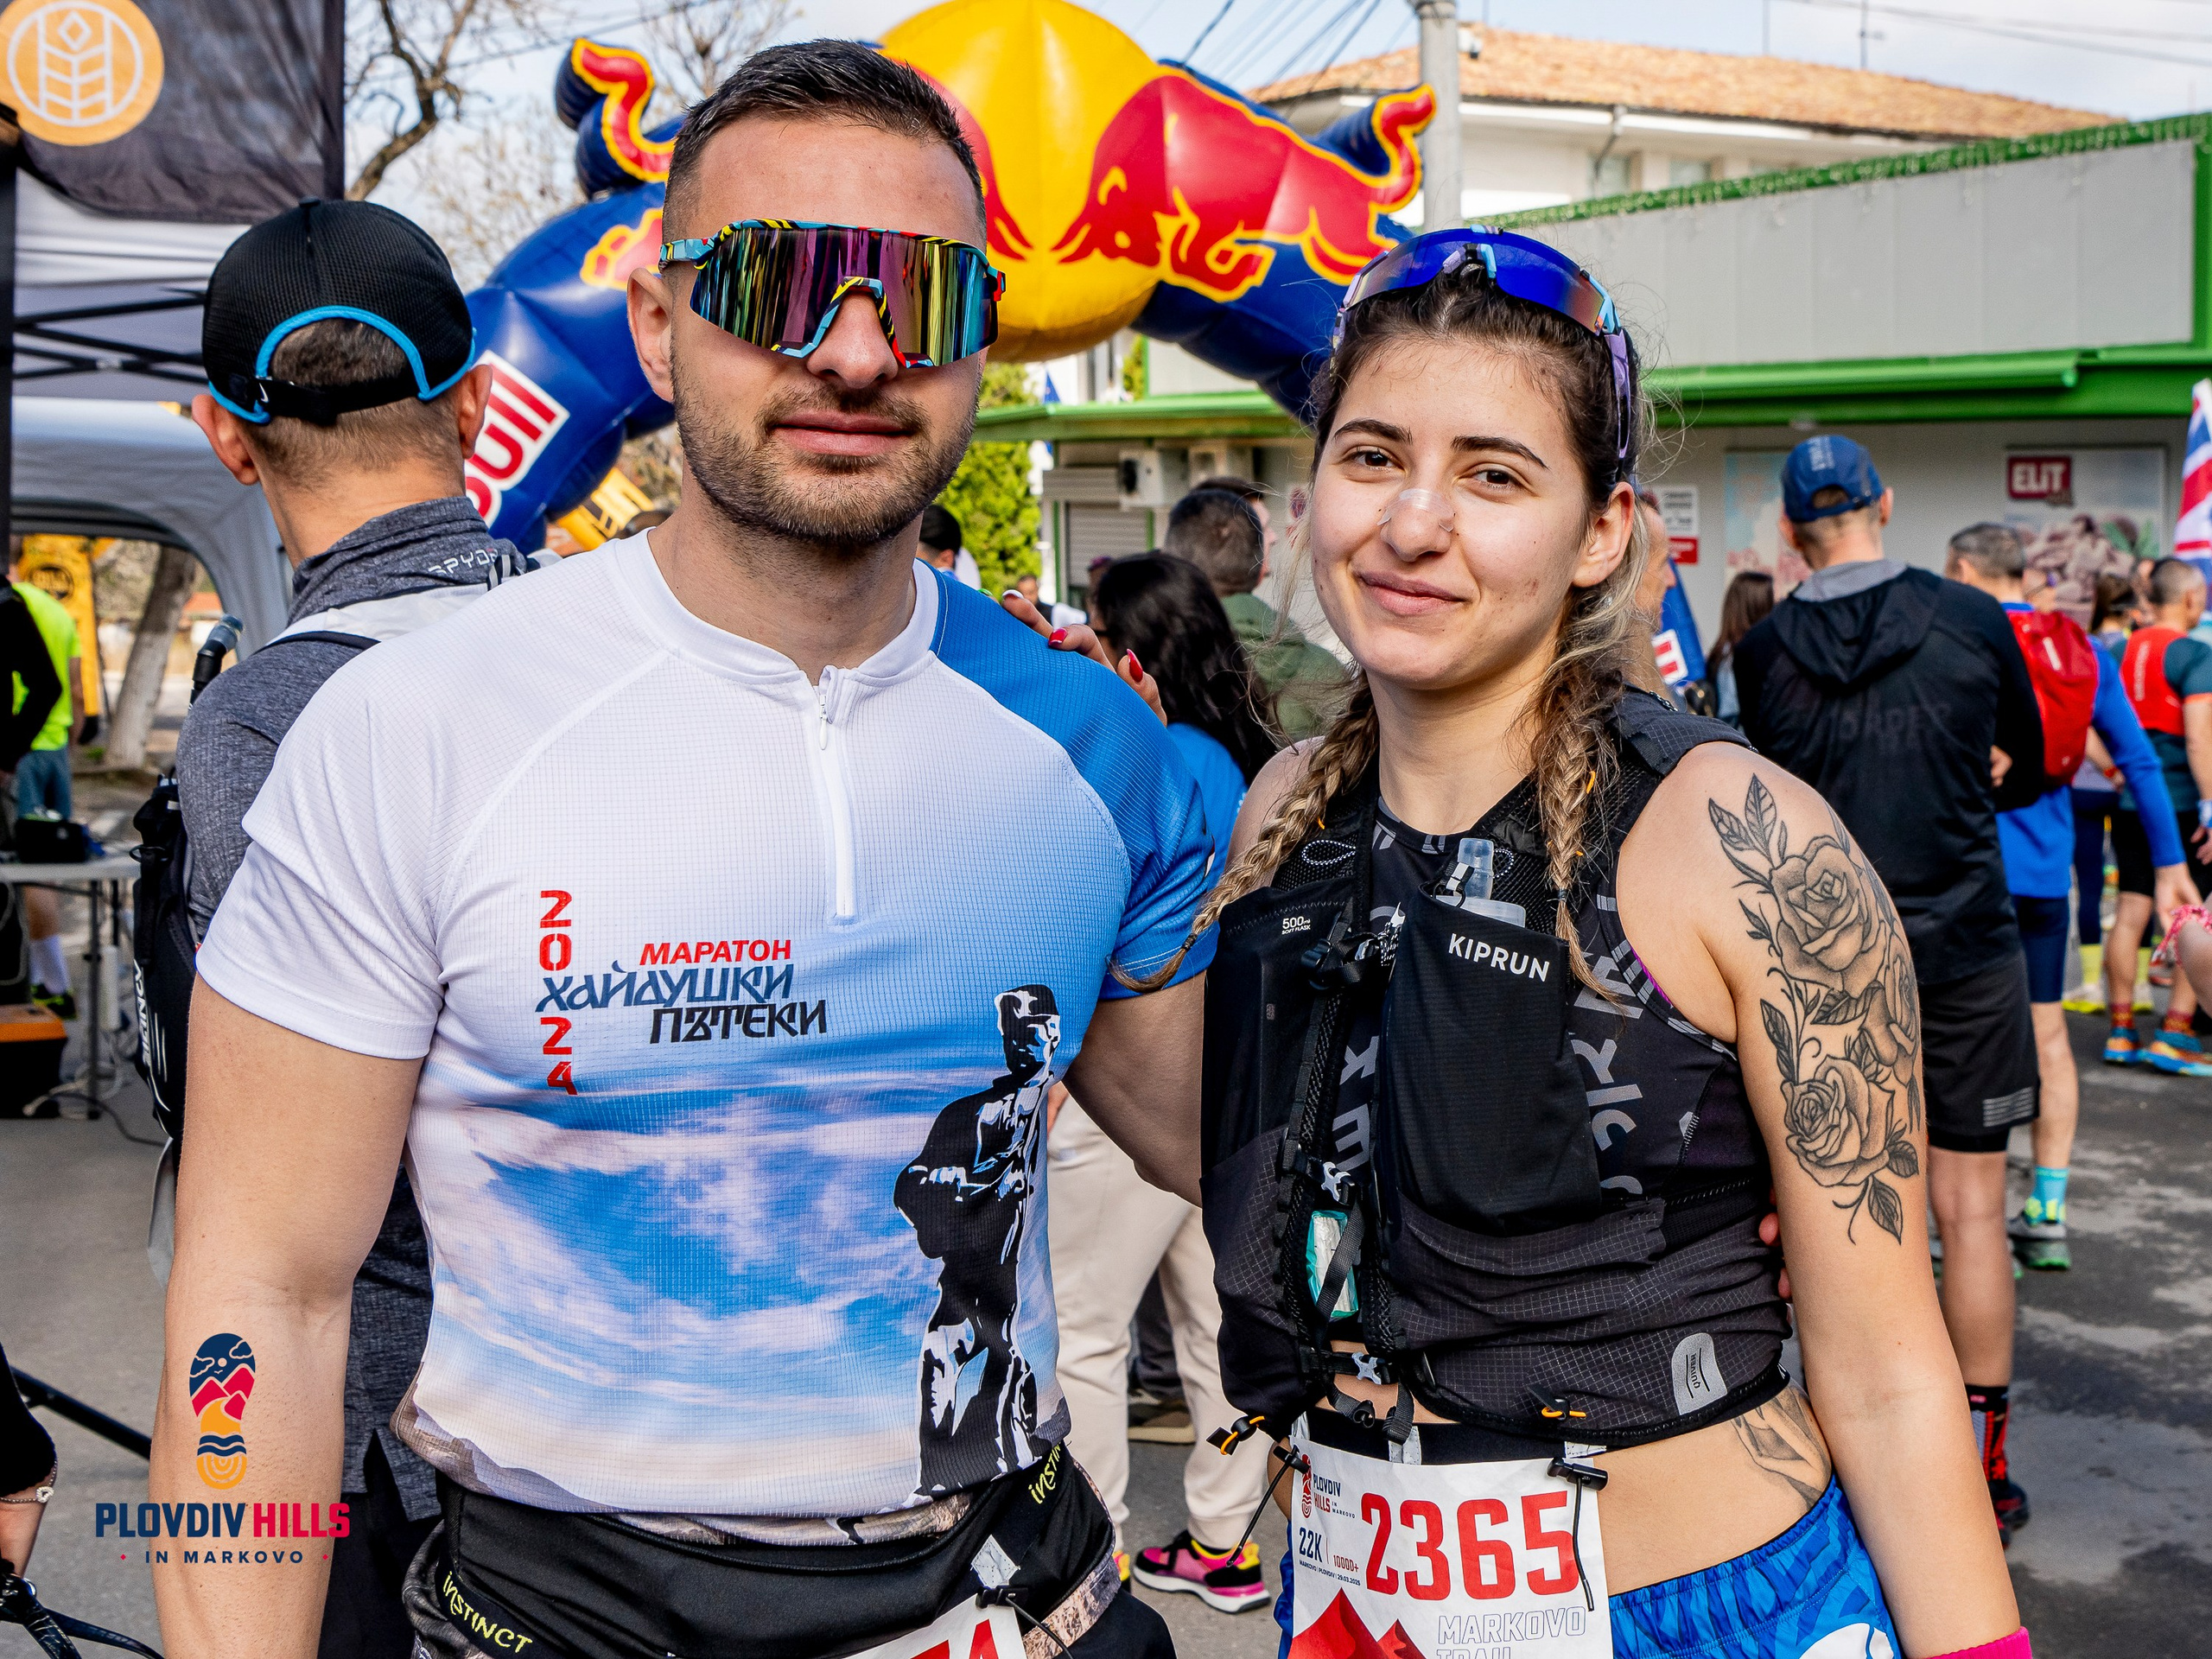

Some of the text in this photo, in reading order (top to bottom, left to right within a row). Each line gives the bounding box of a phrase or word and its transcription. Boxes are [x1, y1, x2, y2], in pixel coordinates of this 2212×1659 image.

[639, 939, 791, 966] МАРАТОН
[1448, 933, 1550, 982] KIPRUN
[1691, 1352, 1701, 1389] QUIVER
[1313, 1472, 1341, 1497] PLOVDIV
[1314, 1492, 1331, 1513] HILLS
[1332, 1508, 1355, 1519] MARKOVO
[1299, 1527, 1323, 1563] 22K
[1361, 1491, 1580, 1602] 2365
[1438, 1605, 1586, 1645] MARKOVO
